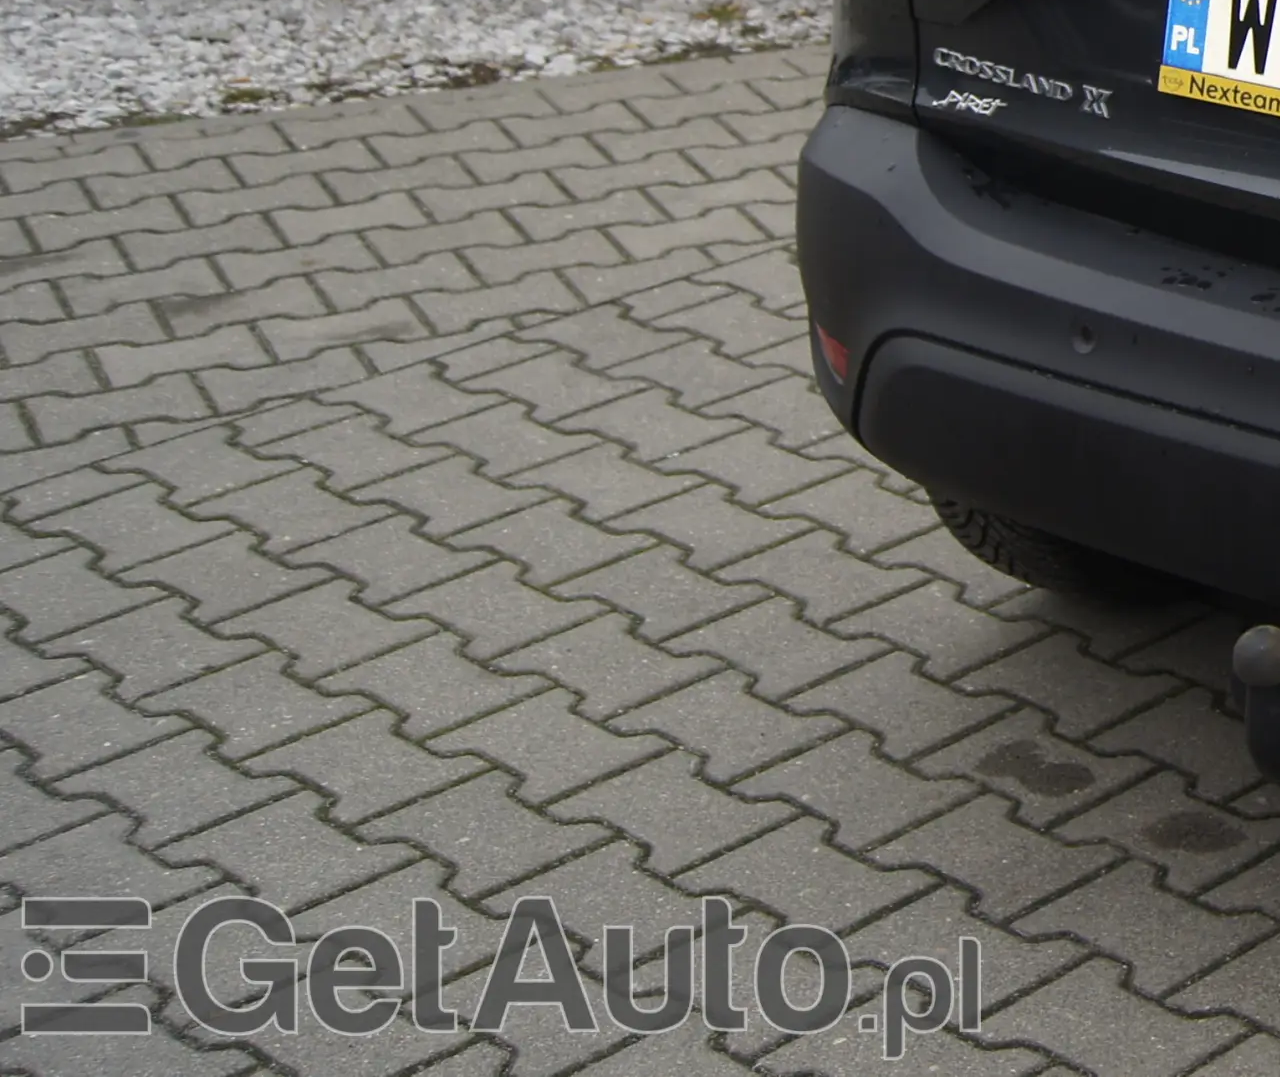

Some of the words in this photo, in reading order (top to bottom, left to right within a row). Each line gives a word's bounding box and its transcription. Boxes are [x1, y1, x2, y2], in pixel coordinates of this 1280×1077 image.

[1170, 24, 1200, 55] PL
[933, 47, 1073, 101] CROSSLAND
[1081, 84, 1113, 119] X
